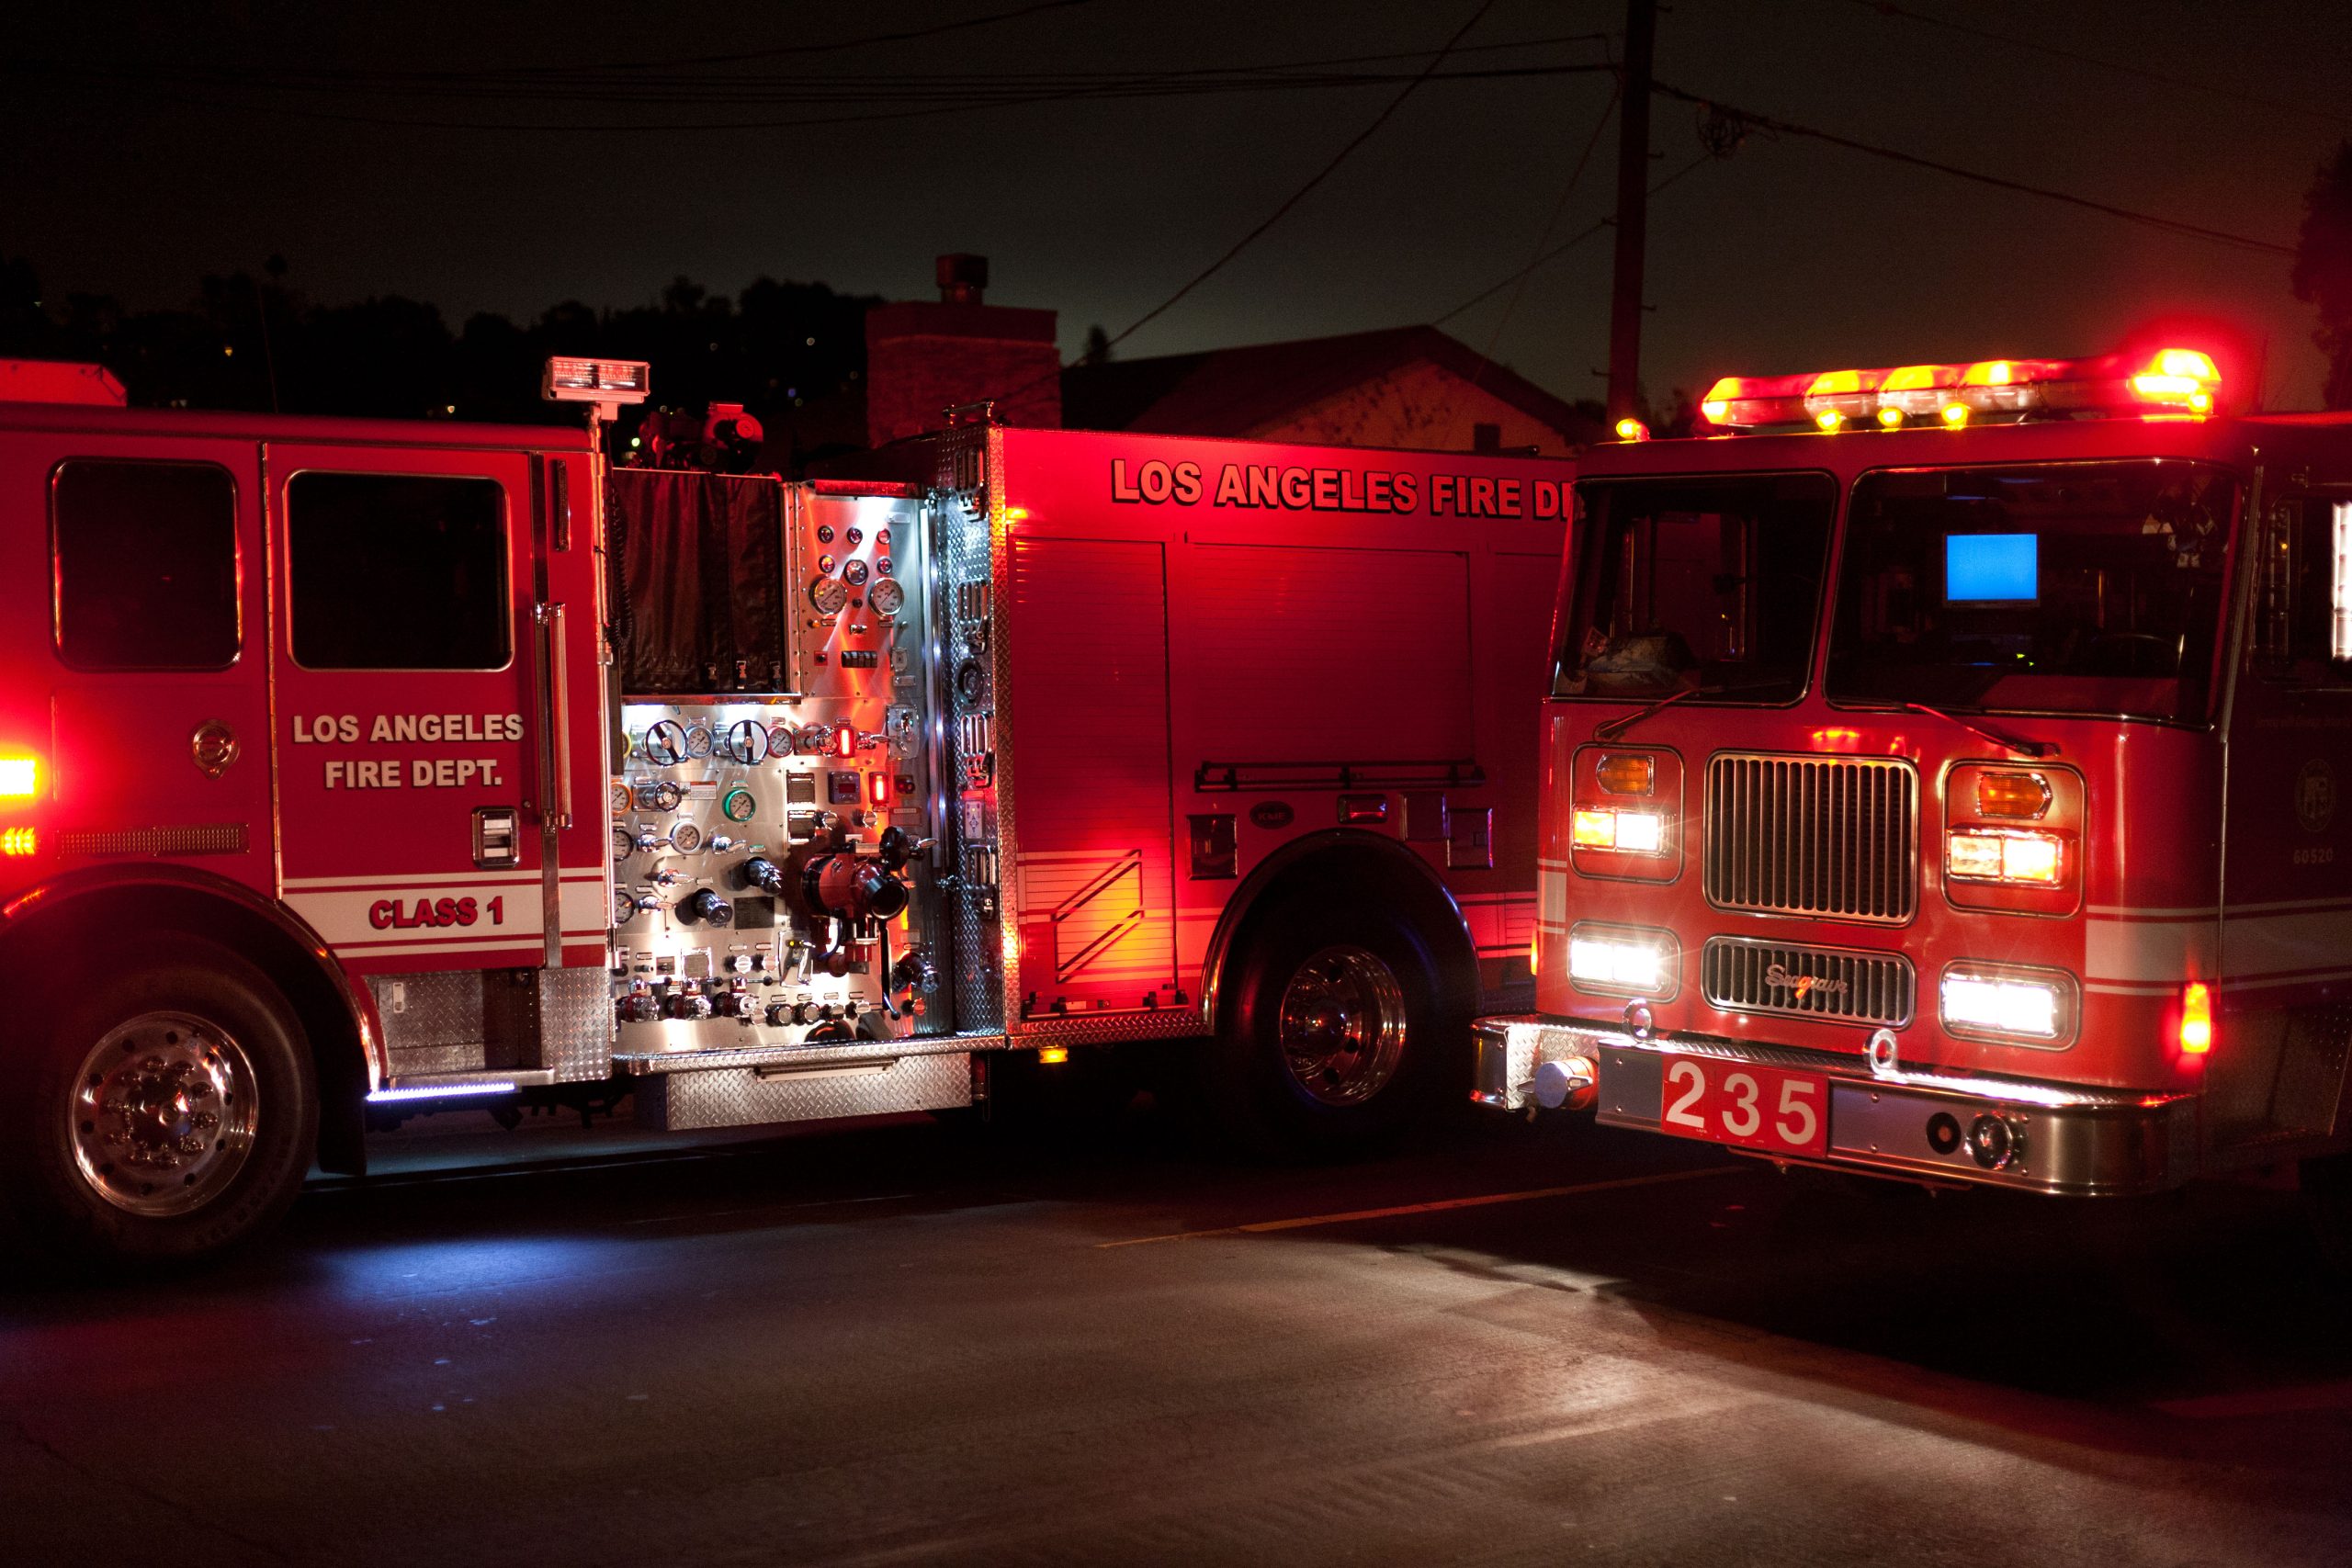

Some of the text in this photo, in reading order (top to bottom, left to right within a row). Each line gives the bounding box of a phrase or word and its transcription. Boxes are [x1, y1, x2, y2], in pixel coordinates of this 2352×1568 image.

[1112, 459, 1203, 504] LOS
[1214, 465, 1419, 514] ANGELES
[1430, 474, 1521, 519] FIRE
[293, 714, 525, 743] LOS ANGELES
[325, 759, 503, 789] FIRE DEPT.
[2292, 847, 2334, 865] 60520
[369, 896, 503, 929] CLASS 1
[1764, 964, 1848, 999] Seagrave
[1666, 1060, 1817, 1145] 235
